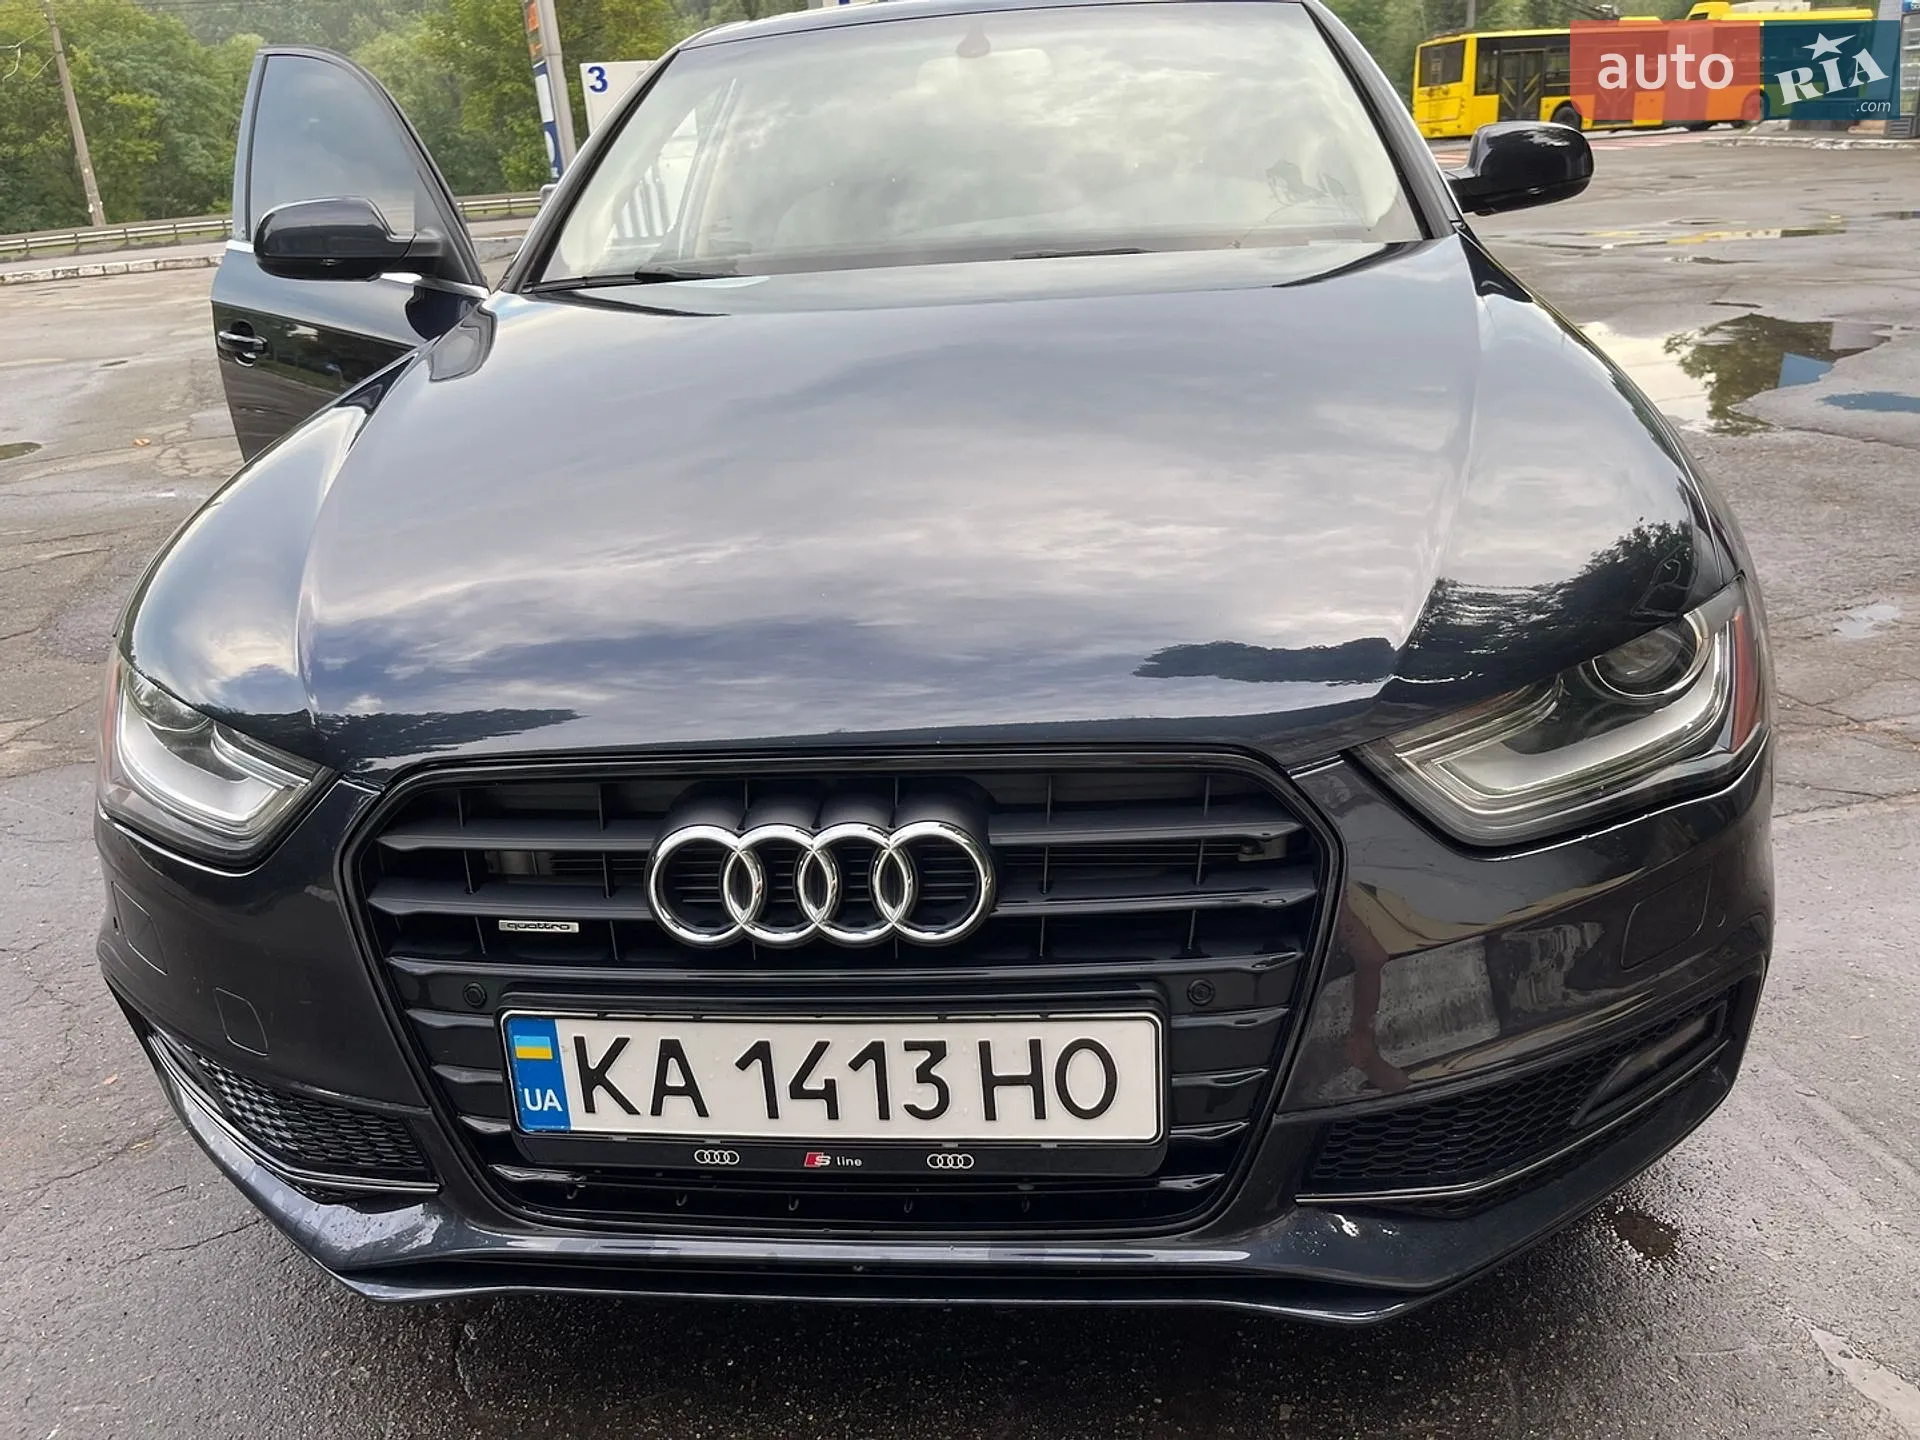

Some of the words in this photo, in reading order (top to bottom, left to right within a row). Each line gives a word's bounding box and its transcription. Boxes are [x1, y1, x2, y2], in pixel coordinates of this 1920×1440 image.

[587, 66, 609, 93] 3
[506, 922, 570, 931] quattro
[573, 1035, 709, 1117] KA
[735, 1040, 950, 1120] 1413
[978, 1038, 1118, 1120] HO
[523, 1088, 563, 1112] UA
[836, 1155, 863, 1167] line
